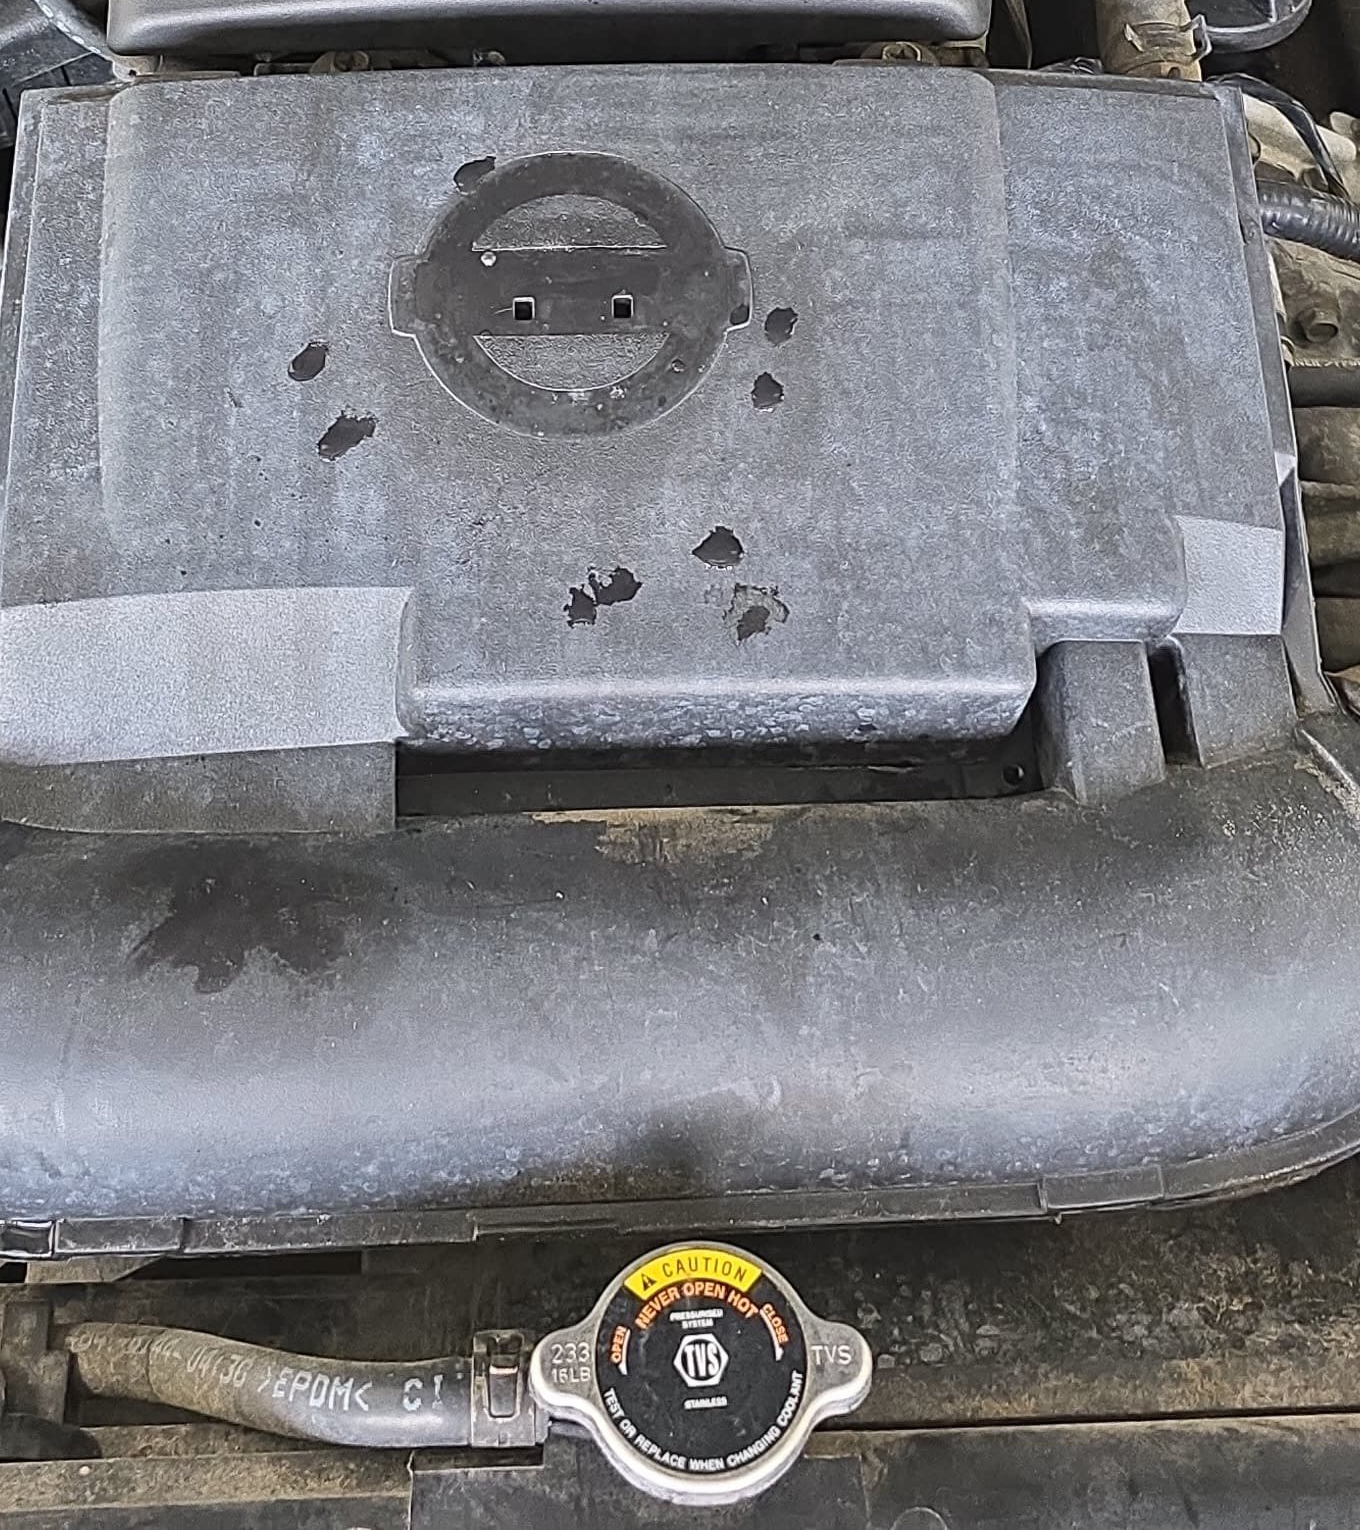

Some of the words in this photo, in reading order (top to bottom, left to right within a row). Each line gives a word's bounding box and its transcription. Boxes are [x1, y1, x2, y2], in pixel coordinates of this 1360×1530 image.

[662, 1256, 748, 1283] CAUTION
[635, 1286, 681, 1330] NEVER
[682, 1281, 726, 1300] OPEN
[726, 1289, 760, 1319] HOT
[681, 1318, 714, 1330] SYSTEM
[761, 1302, 790, 1345] CLOSE
[550, 1343, 591, 1363] 233
[609, 1326, 627, 1365] OPEN
[684, 1342, 721, 1378] TVS
[811, 1345, 852, 1366] TVS
[551, 1368, 592, 1384] 16LB
[604, 1387, 625, 1419] TEST
[621, 1419, 638, 1439] OR
[634, 1434, 686, 1470] REPLACE
[689, 1457, 725, 1471] WHEN
[727, 1424, 782, 1468] CHANGING
[777, 1370, 804, 1427] COOLANT
